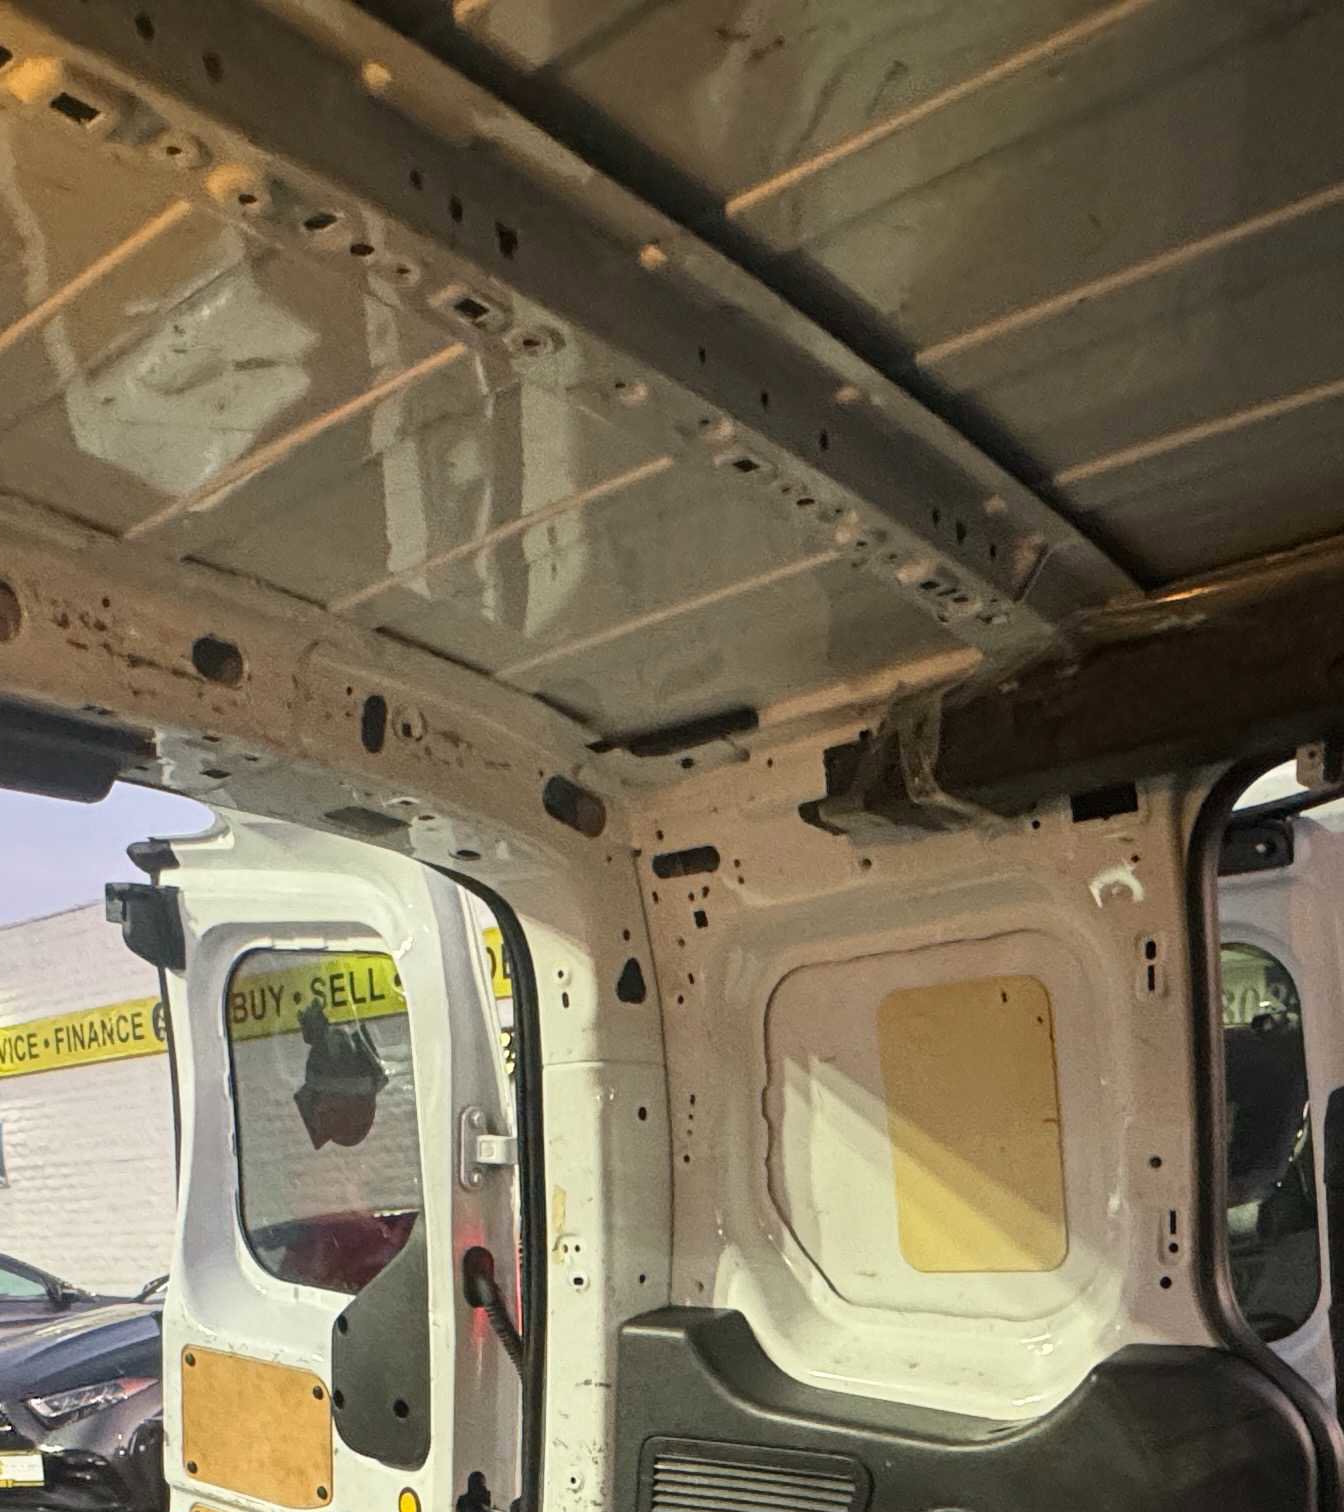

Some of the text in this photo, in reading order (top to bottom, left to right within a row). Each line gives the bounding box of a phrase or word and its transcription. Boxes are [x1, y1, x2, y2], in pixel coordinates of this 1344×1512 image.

[231, 967, 386, 1024] BUY SELL
[54, 1012, 145, 1054] FINANCE
